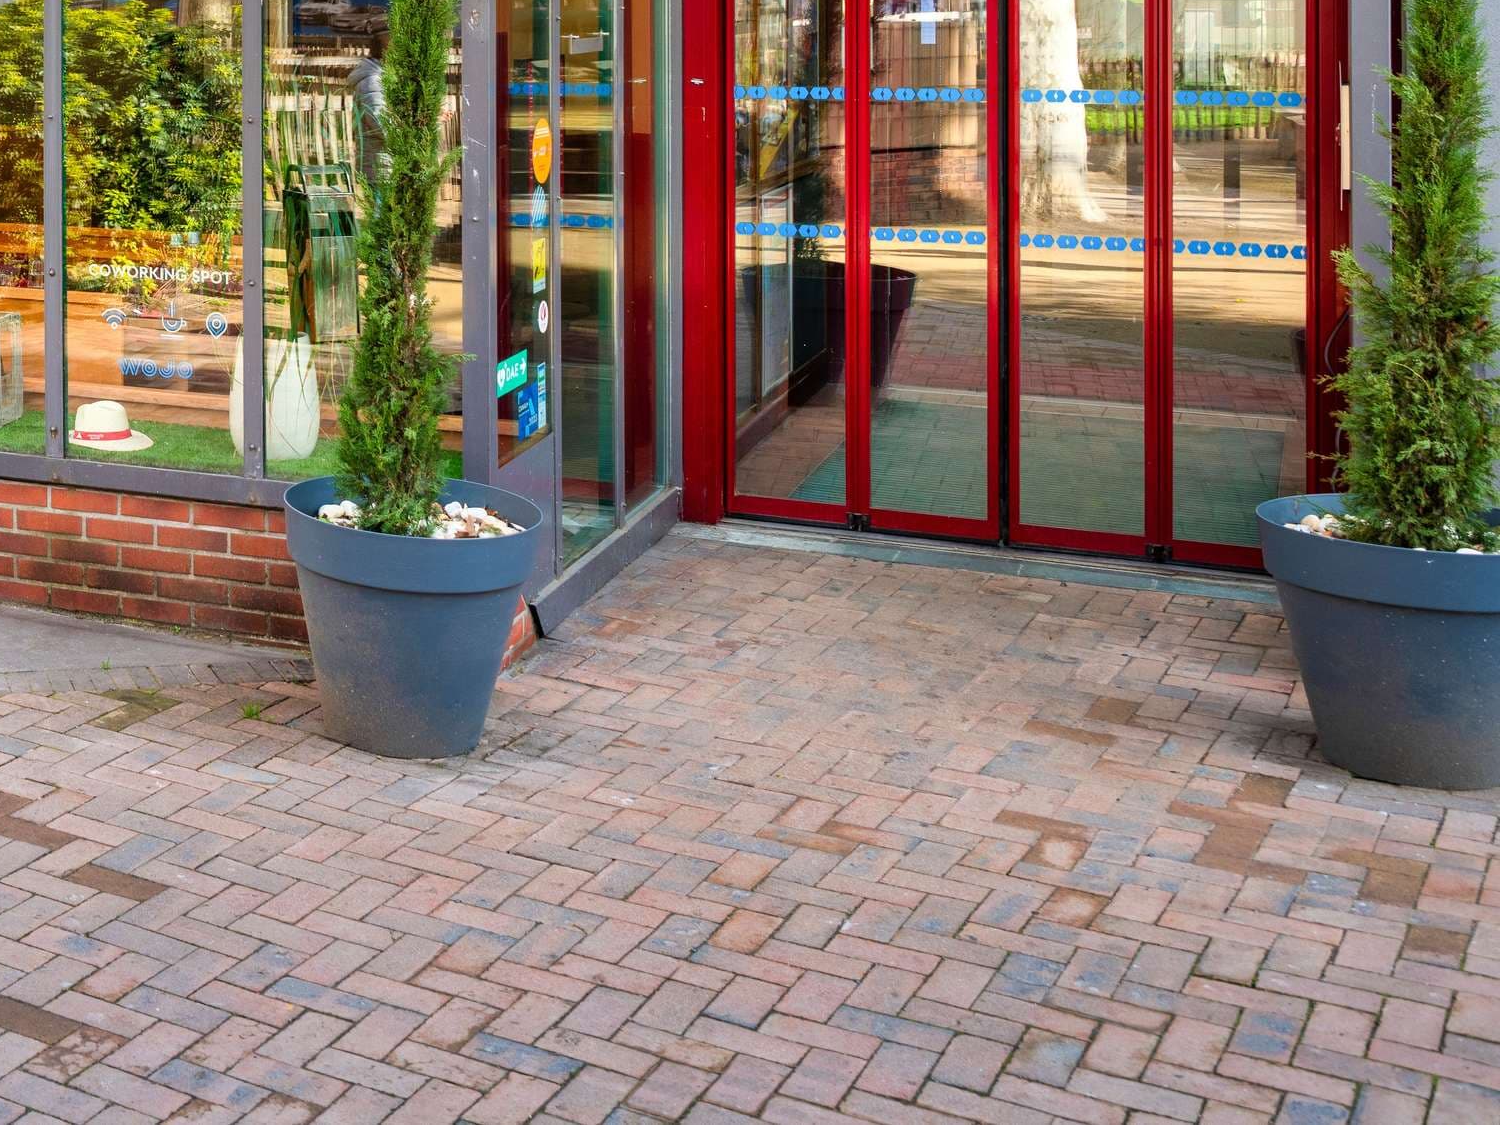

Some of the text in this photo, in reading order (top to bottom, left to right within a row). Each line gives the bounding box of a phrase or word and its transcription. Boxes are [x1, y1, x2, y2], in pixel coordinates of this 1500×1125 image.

[88, 263, 233, 285] COWORKING SPOT
[118, 357, 195, 379] WOJO
[506, 362, 519, 382] DAE
